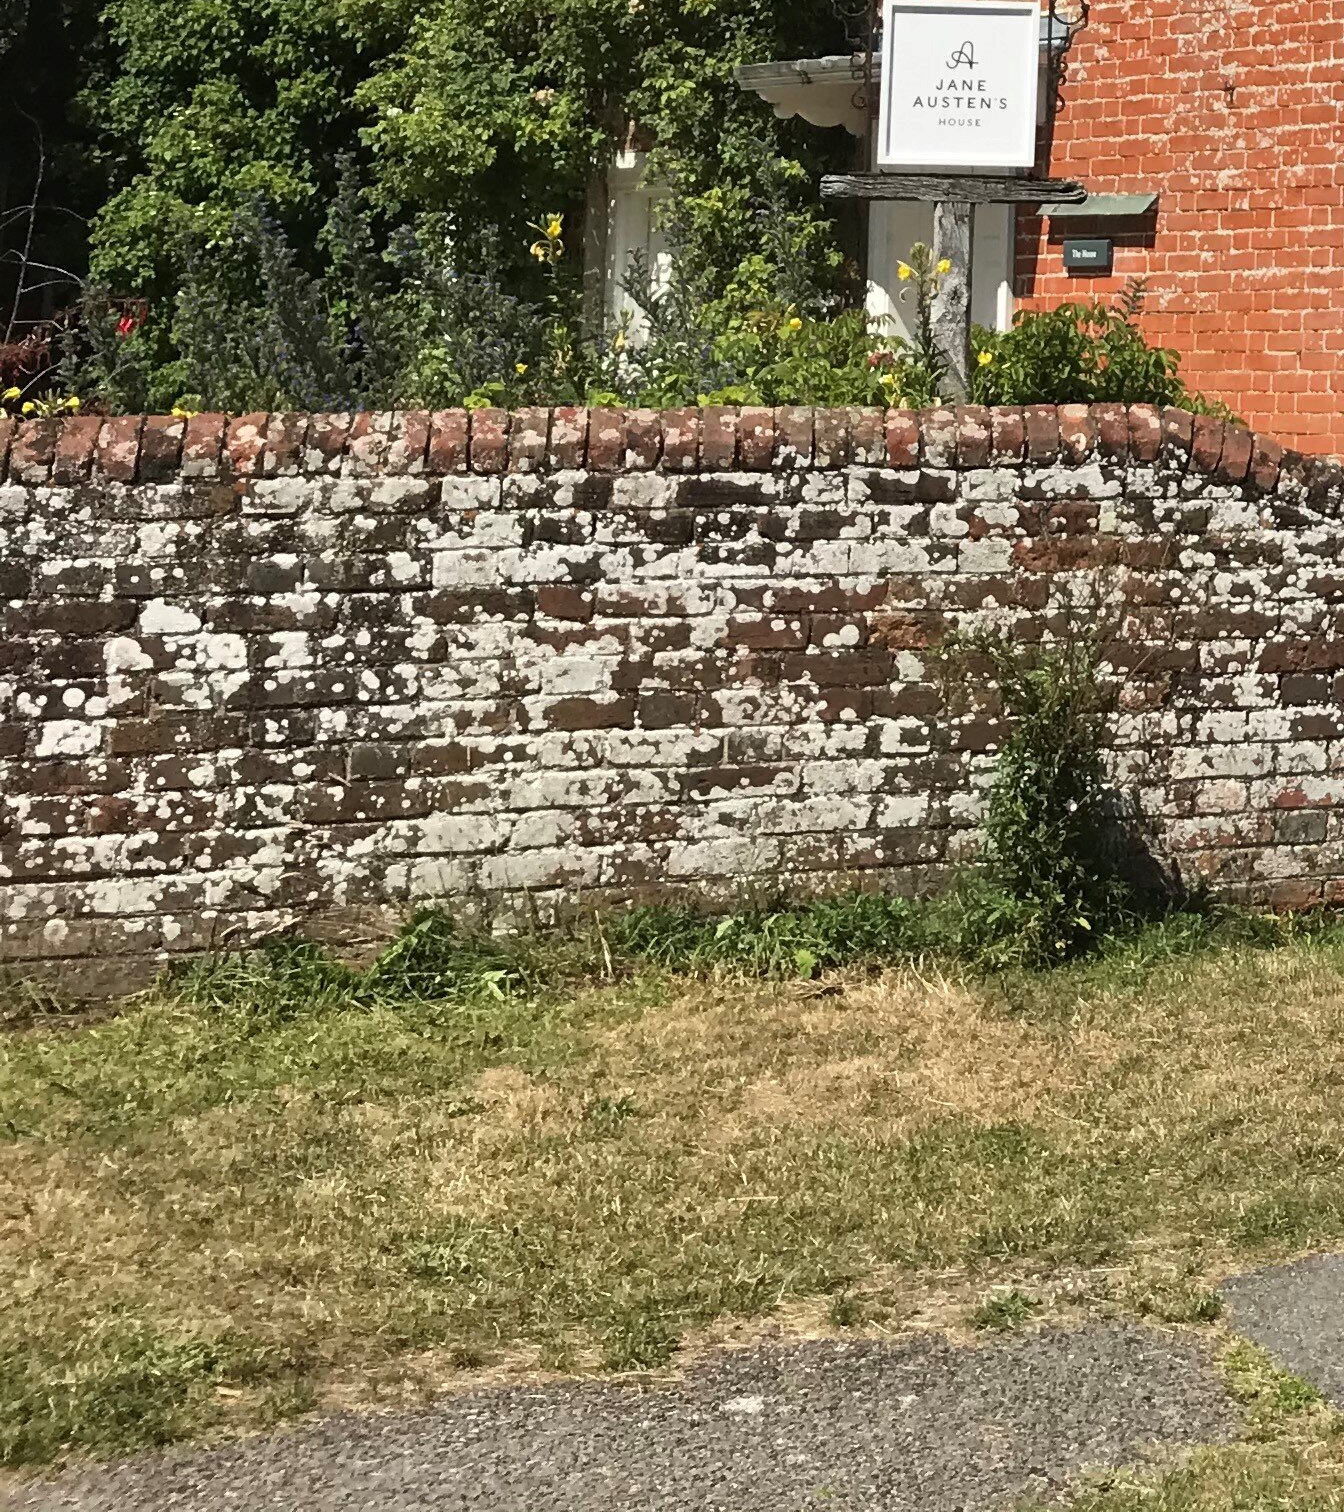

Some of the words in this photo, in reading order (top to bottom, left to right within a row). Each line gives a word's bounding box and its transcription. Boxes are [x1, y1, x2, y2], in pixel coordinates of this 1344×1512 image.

[935, 79, 986, 91] JANE
[912, 96, 1008, 110] AUSTEN'S
[938, 118, 981, 127] HOUSE
